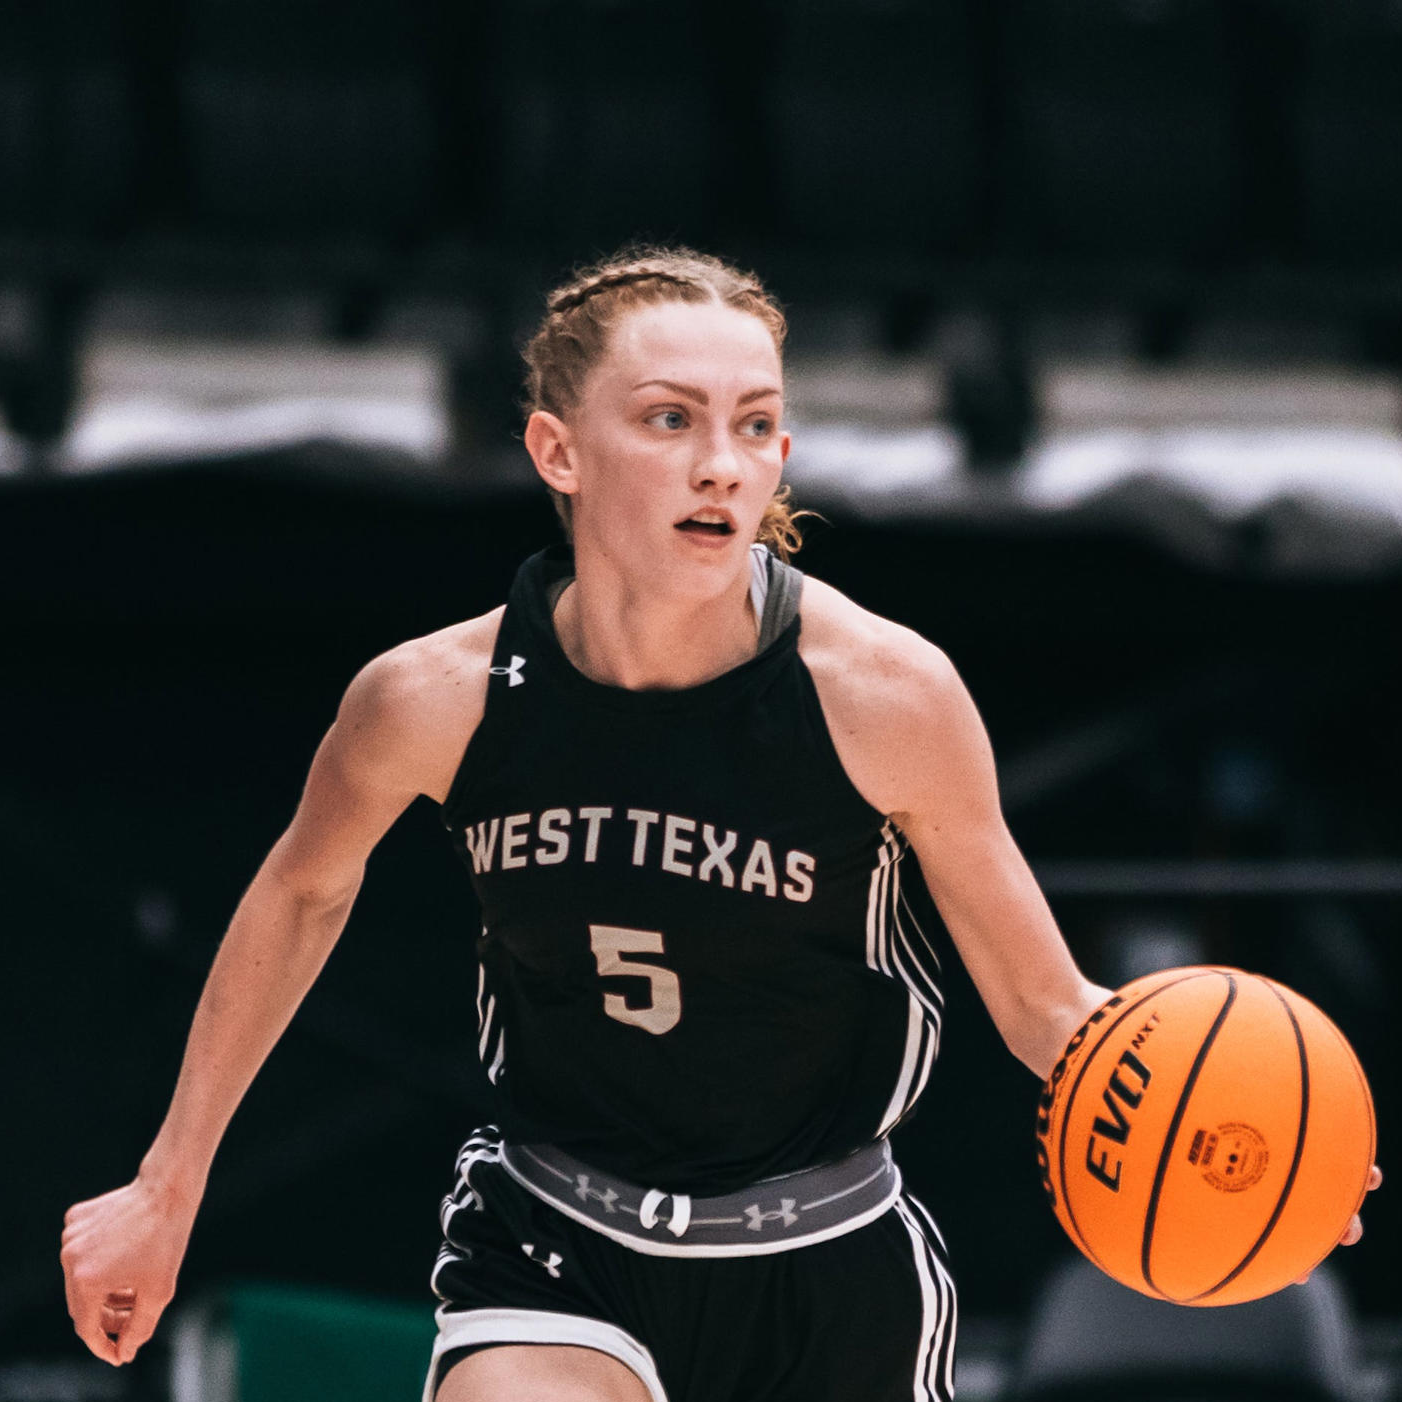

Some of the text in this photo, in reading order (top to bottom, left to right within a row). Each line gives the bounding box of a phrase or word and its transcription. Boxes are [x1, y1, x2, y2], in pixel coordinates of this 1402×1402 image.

[465, 806, 817, 902] WEST TEXAS
[588, 923, 682, 1036] 5
[1085, 1050, 1152, 1193] EVO
